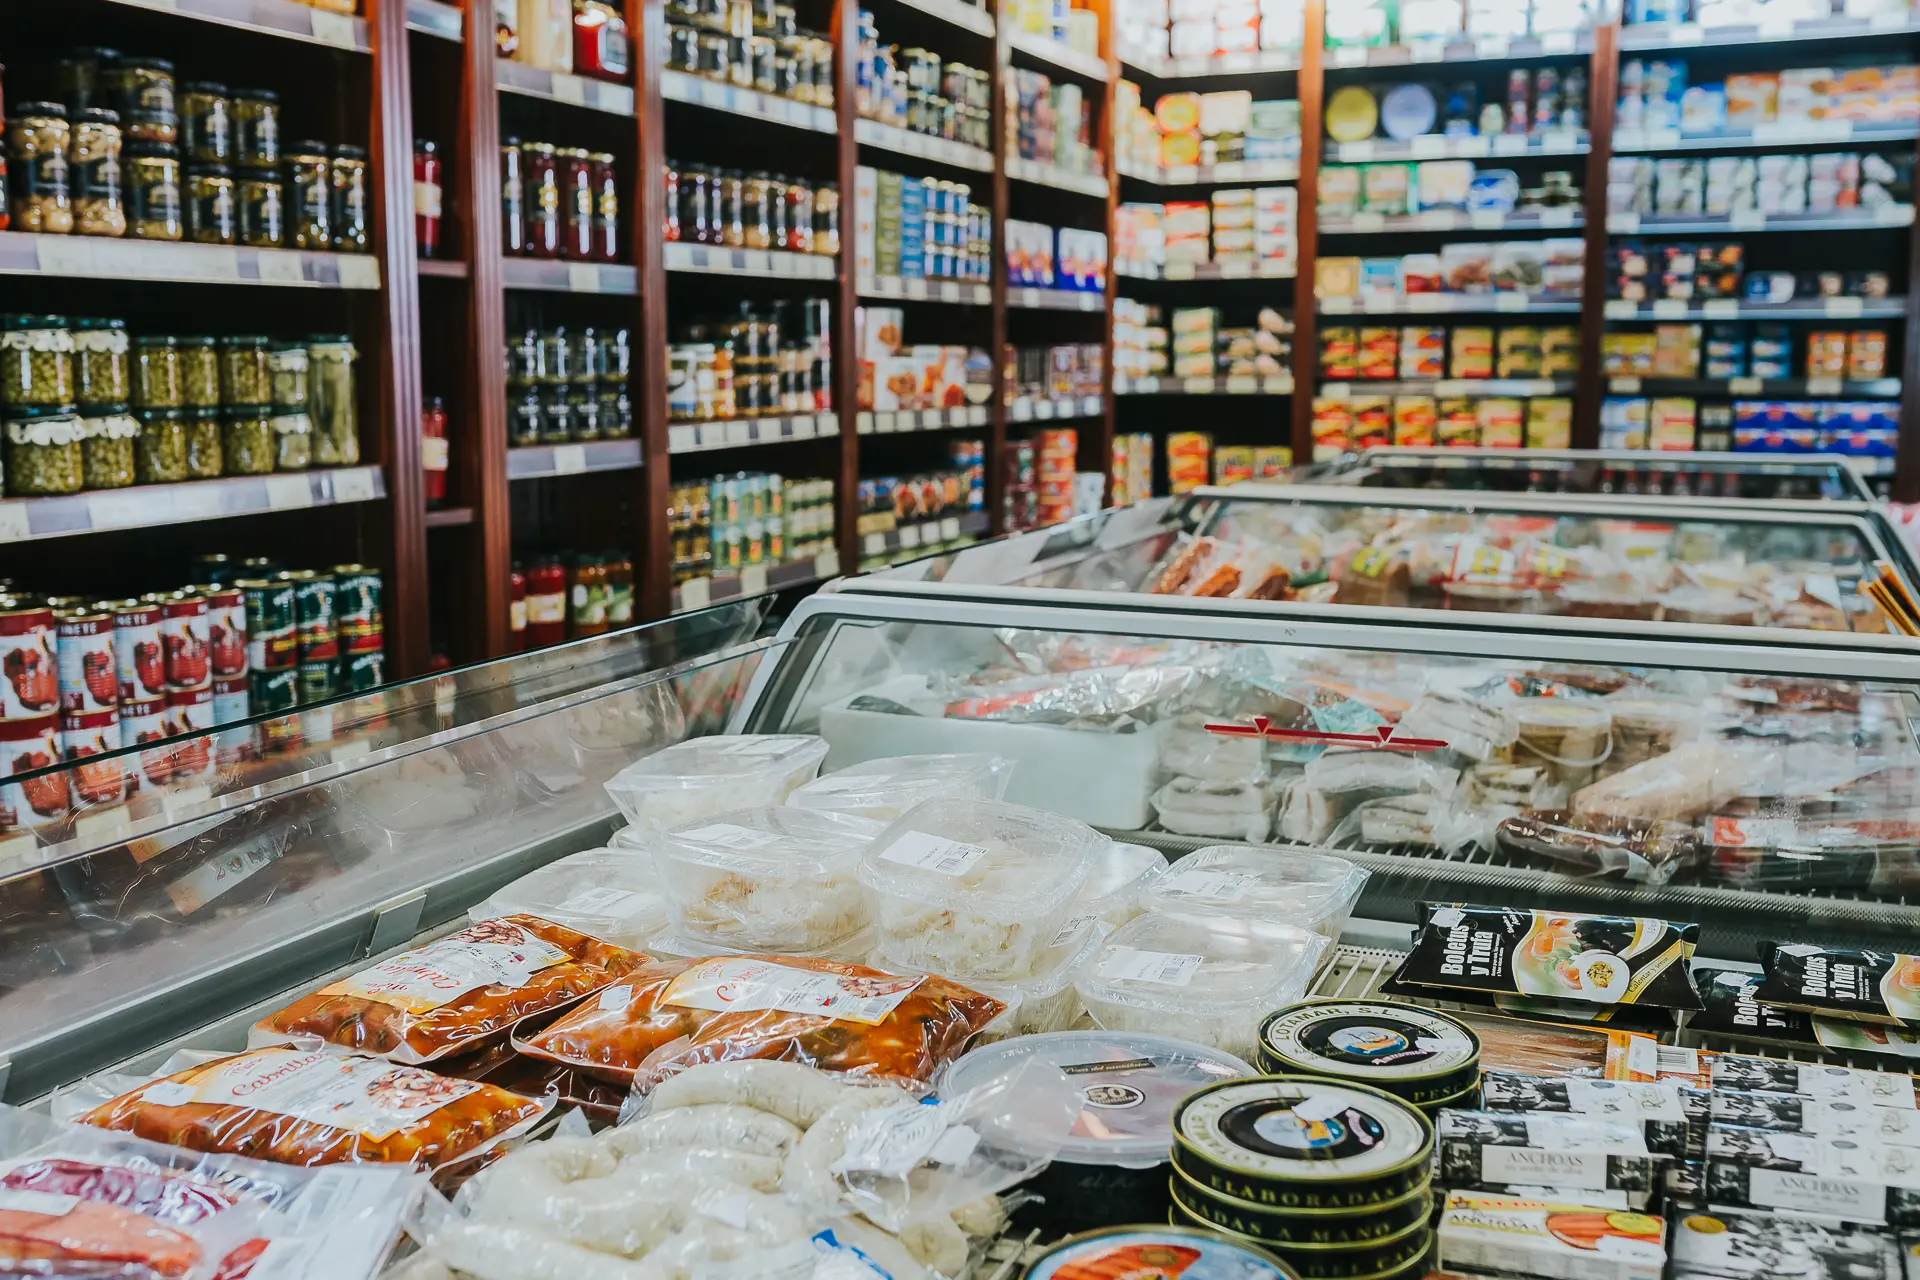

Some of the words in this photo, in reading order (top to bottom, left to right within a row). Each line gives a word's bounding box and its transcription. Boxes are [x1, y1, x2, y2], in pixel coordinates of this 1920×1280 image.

[1440, 924, 1470, 976] Boletus
[1466, 931, 1494, 964] Trufa
[1470, 965, 1490, 977] y
[1801, 956, 1828, 998] Boletus
[1829, 963, 1856, 990] Trufa
[1733, 984, 1760, 1027] Boletus
[1834, 988, 1857, 1000] y
[1358, 1006, 1400, 1017] S.L.
[1088, 1086, 1127, 1100] 50
[1413, 1082, 1470, 1101] PESC
[1507, 1151, 1584, 1166] ANCHOAS
[1210, 1174, 1395, 1206] ELABORADAS
